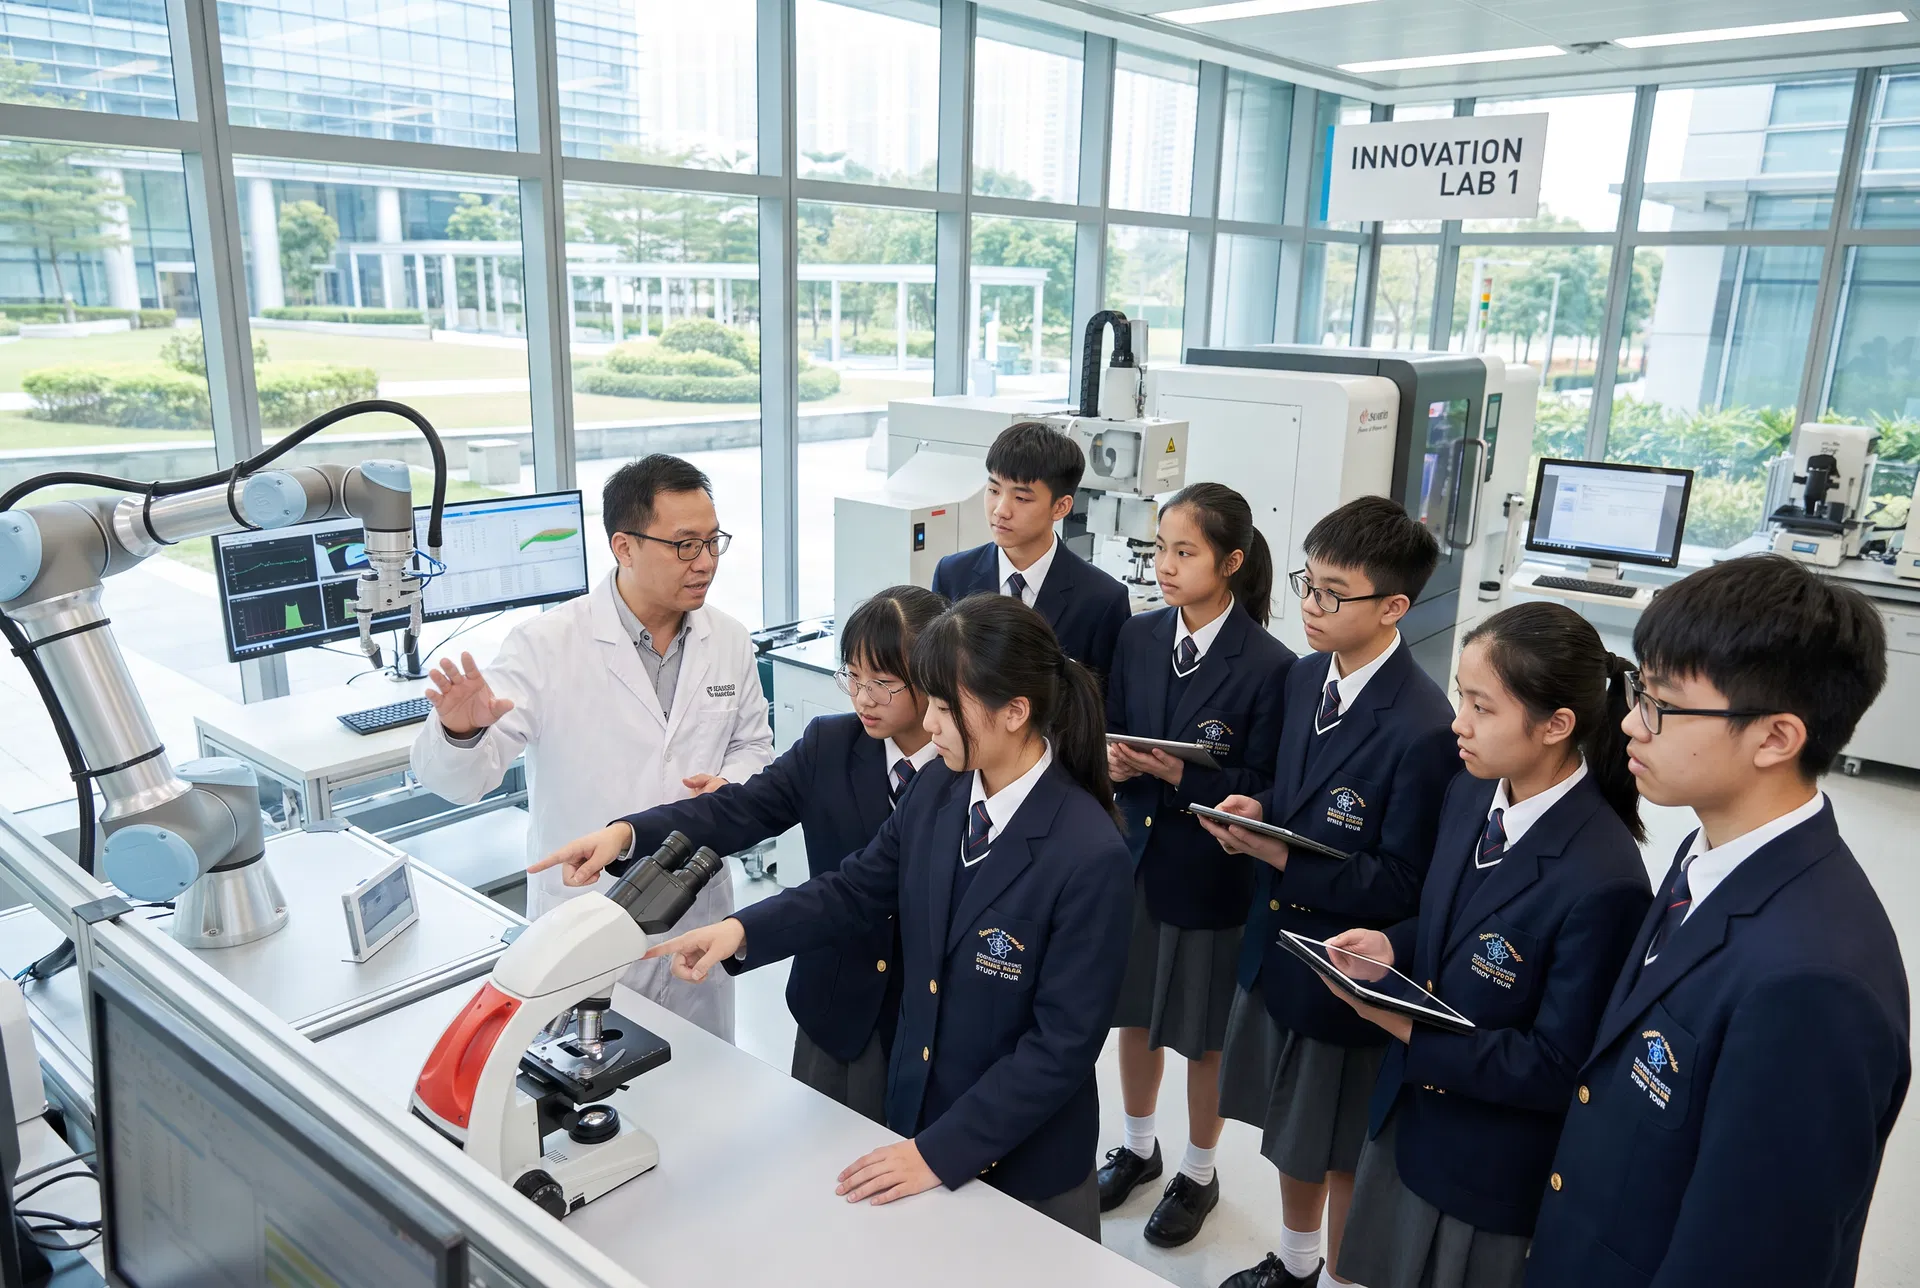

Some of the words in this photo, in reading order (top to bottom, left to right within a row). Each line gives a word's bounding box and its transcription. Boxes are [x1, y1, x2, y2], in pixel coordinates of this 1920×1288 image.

[1352, 137, 1523, 170] INNOVATION
[1440, 171, 1496, 196] LAB
[1508, 169, 1519, 195] 1
[975, 964, 998, 977] STUDY
[999, 971, 1019, 981] TOUR
[1492, 976, 1512, 989] TOUR
